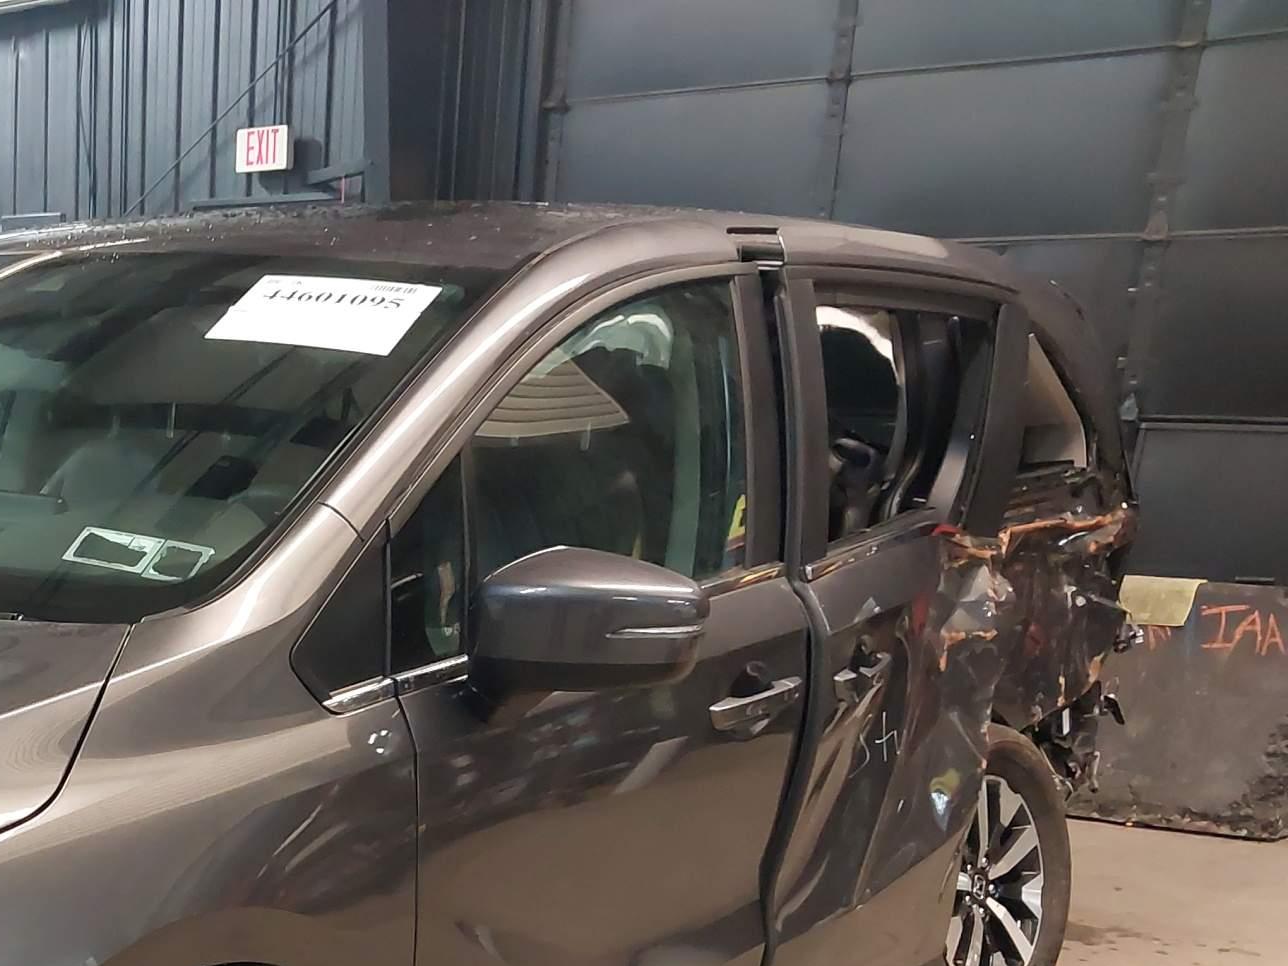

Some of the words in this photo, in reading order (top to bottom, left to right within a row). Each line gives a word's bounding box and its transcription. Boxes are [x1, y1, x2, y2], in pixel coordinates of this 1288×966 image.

[246, 128, 279, 166] EXIT
[263, 288, 406, 310] 44601095
[1200, 605, 1285, 656] IAA
